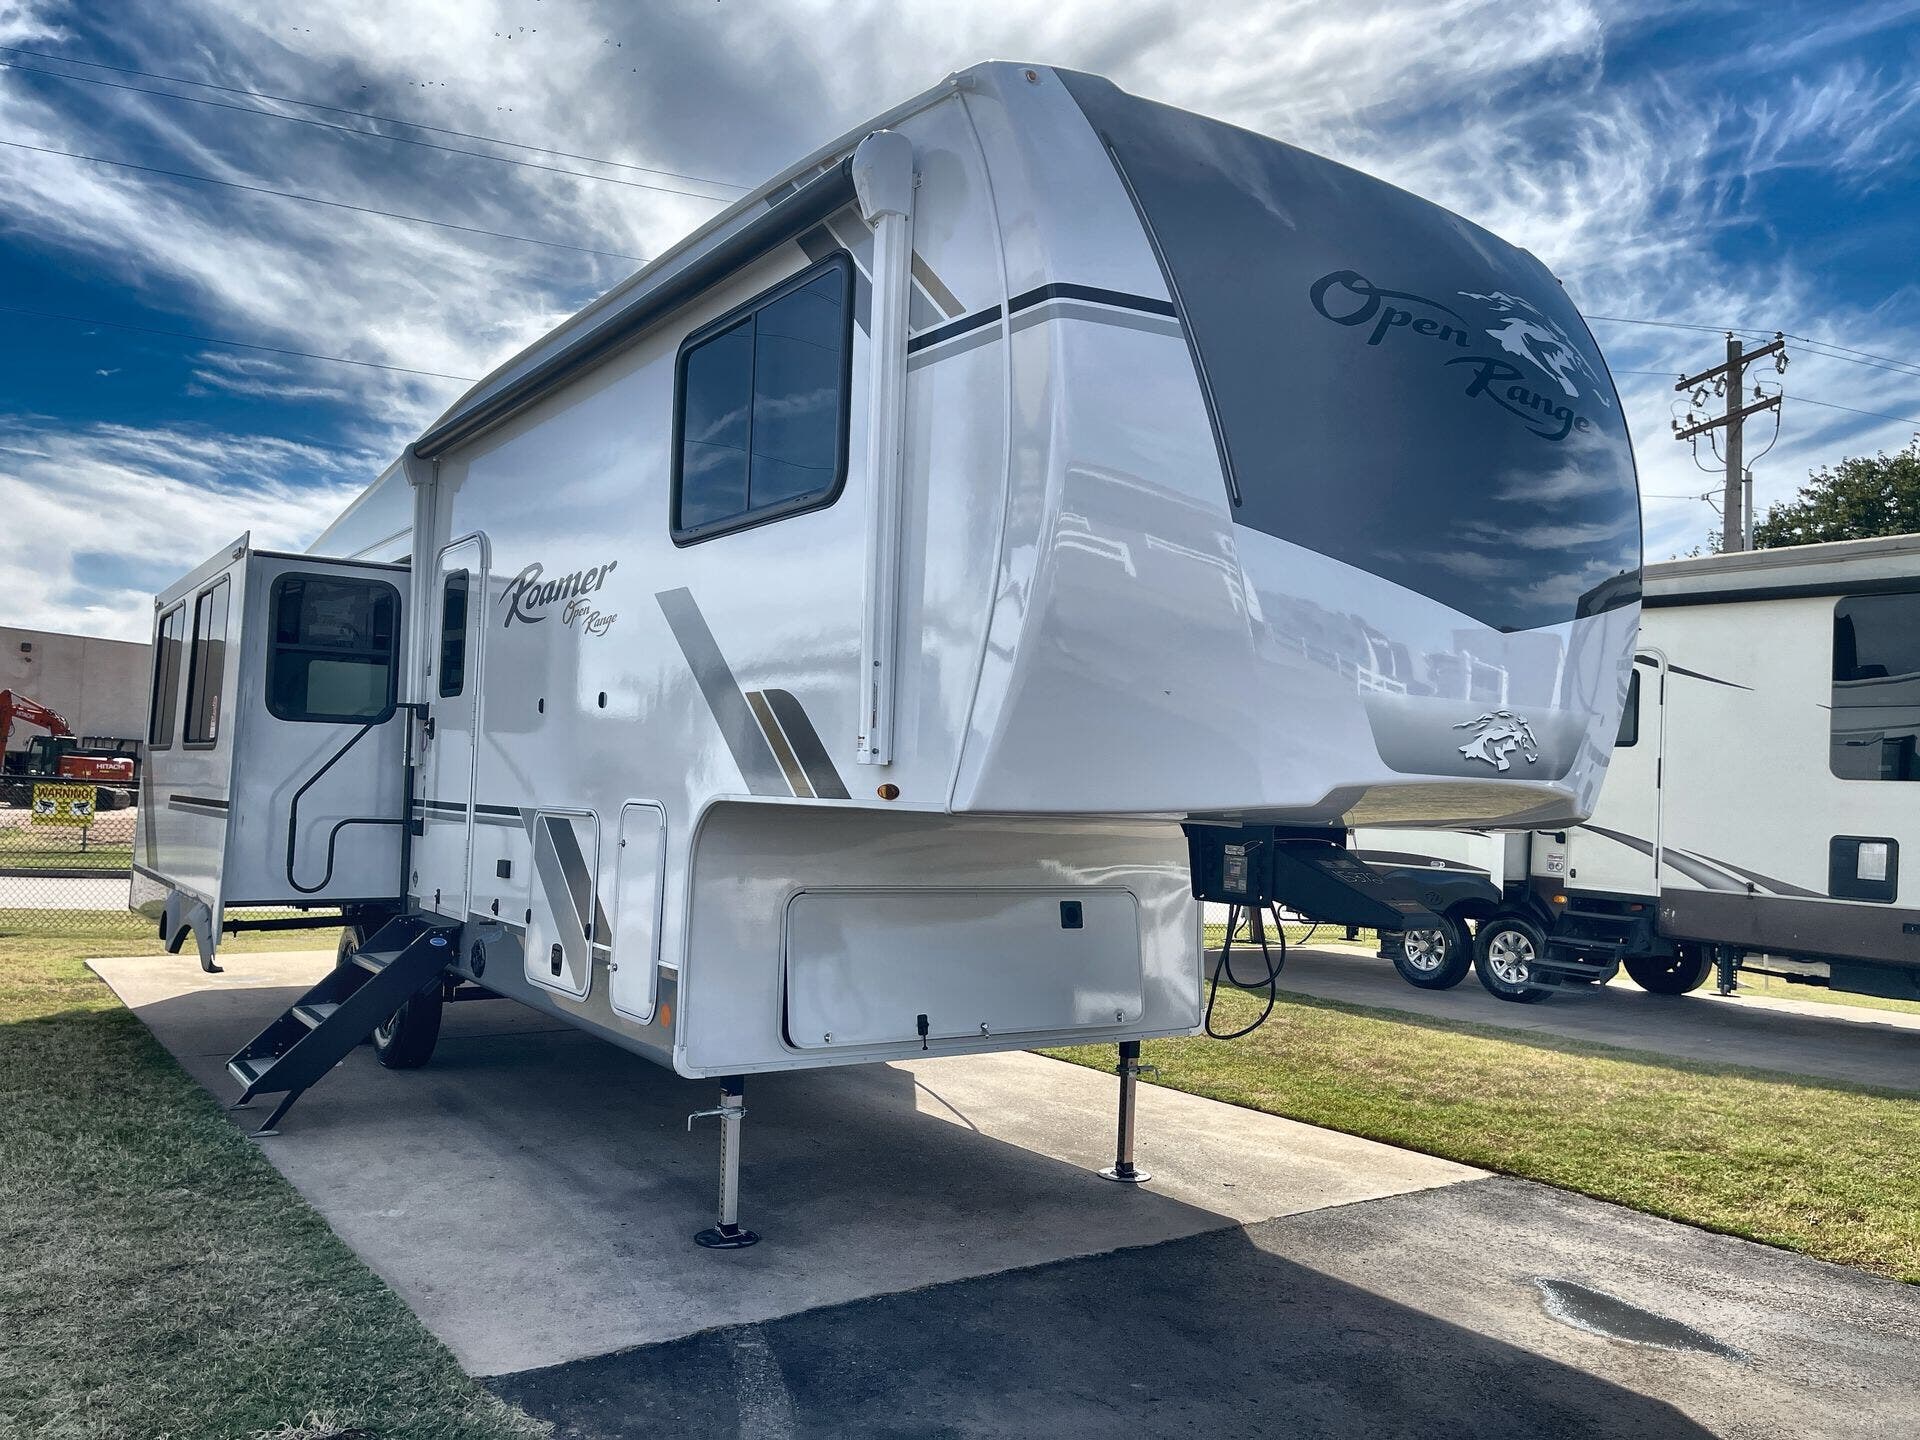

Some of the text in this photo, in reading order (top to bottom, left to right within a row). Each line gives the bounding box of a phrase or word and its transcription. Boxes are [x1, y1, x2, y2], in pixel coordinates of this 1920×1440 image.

[1309, 269, 1472, 346] Open
[1443, 356, 1592, 441] Range
[498, 560, 618, 628] Roamer
[562, 598, 592, 629] Open
[582, 610, 618, 637] Range
